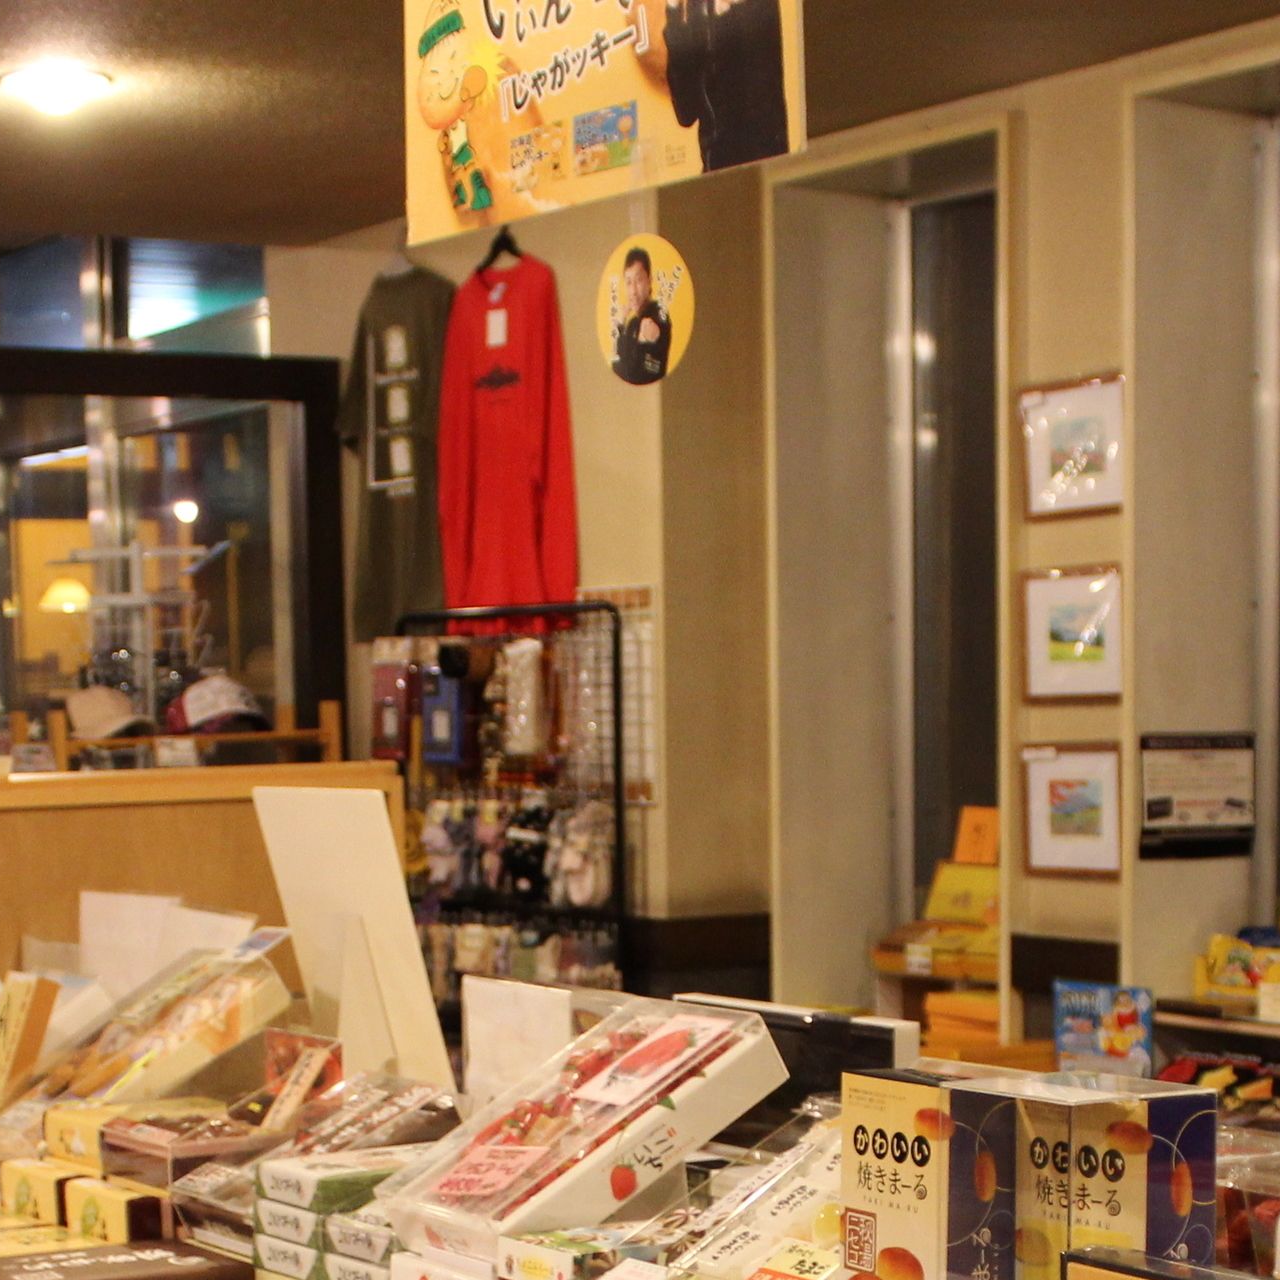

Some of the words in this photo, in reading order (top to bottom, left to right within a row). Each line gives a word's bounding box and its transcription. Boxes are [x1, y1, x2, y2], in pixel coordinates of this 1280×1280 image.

[853, 1124, 931, 1167] かわいい
[1029, 1136, 1125, 1182] かわいい
[857, 1161, 928, 1201] 焼きまーる
